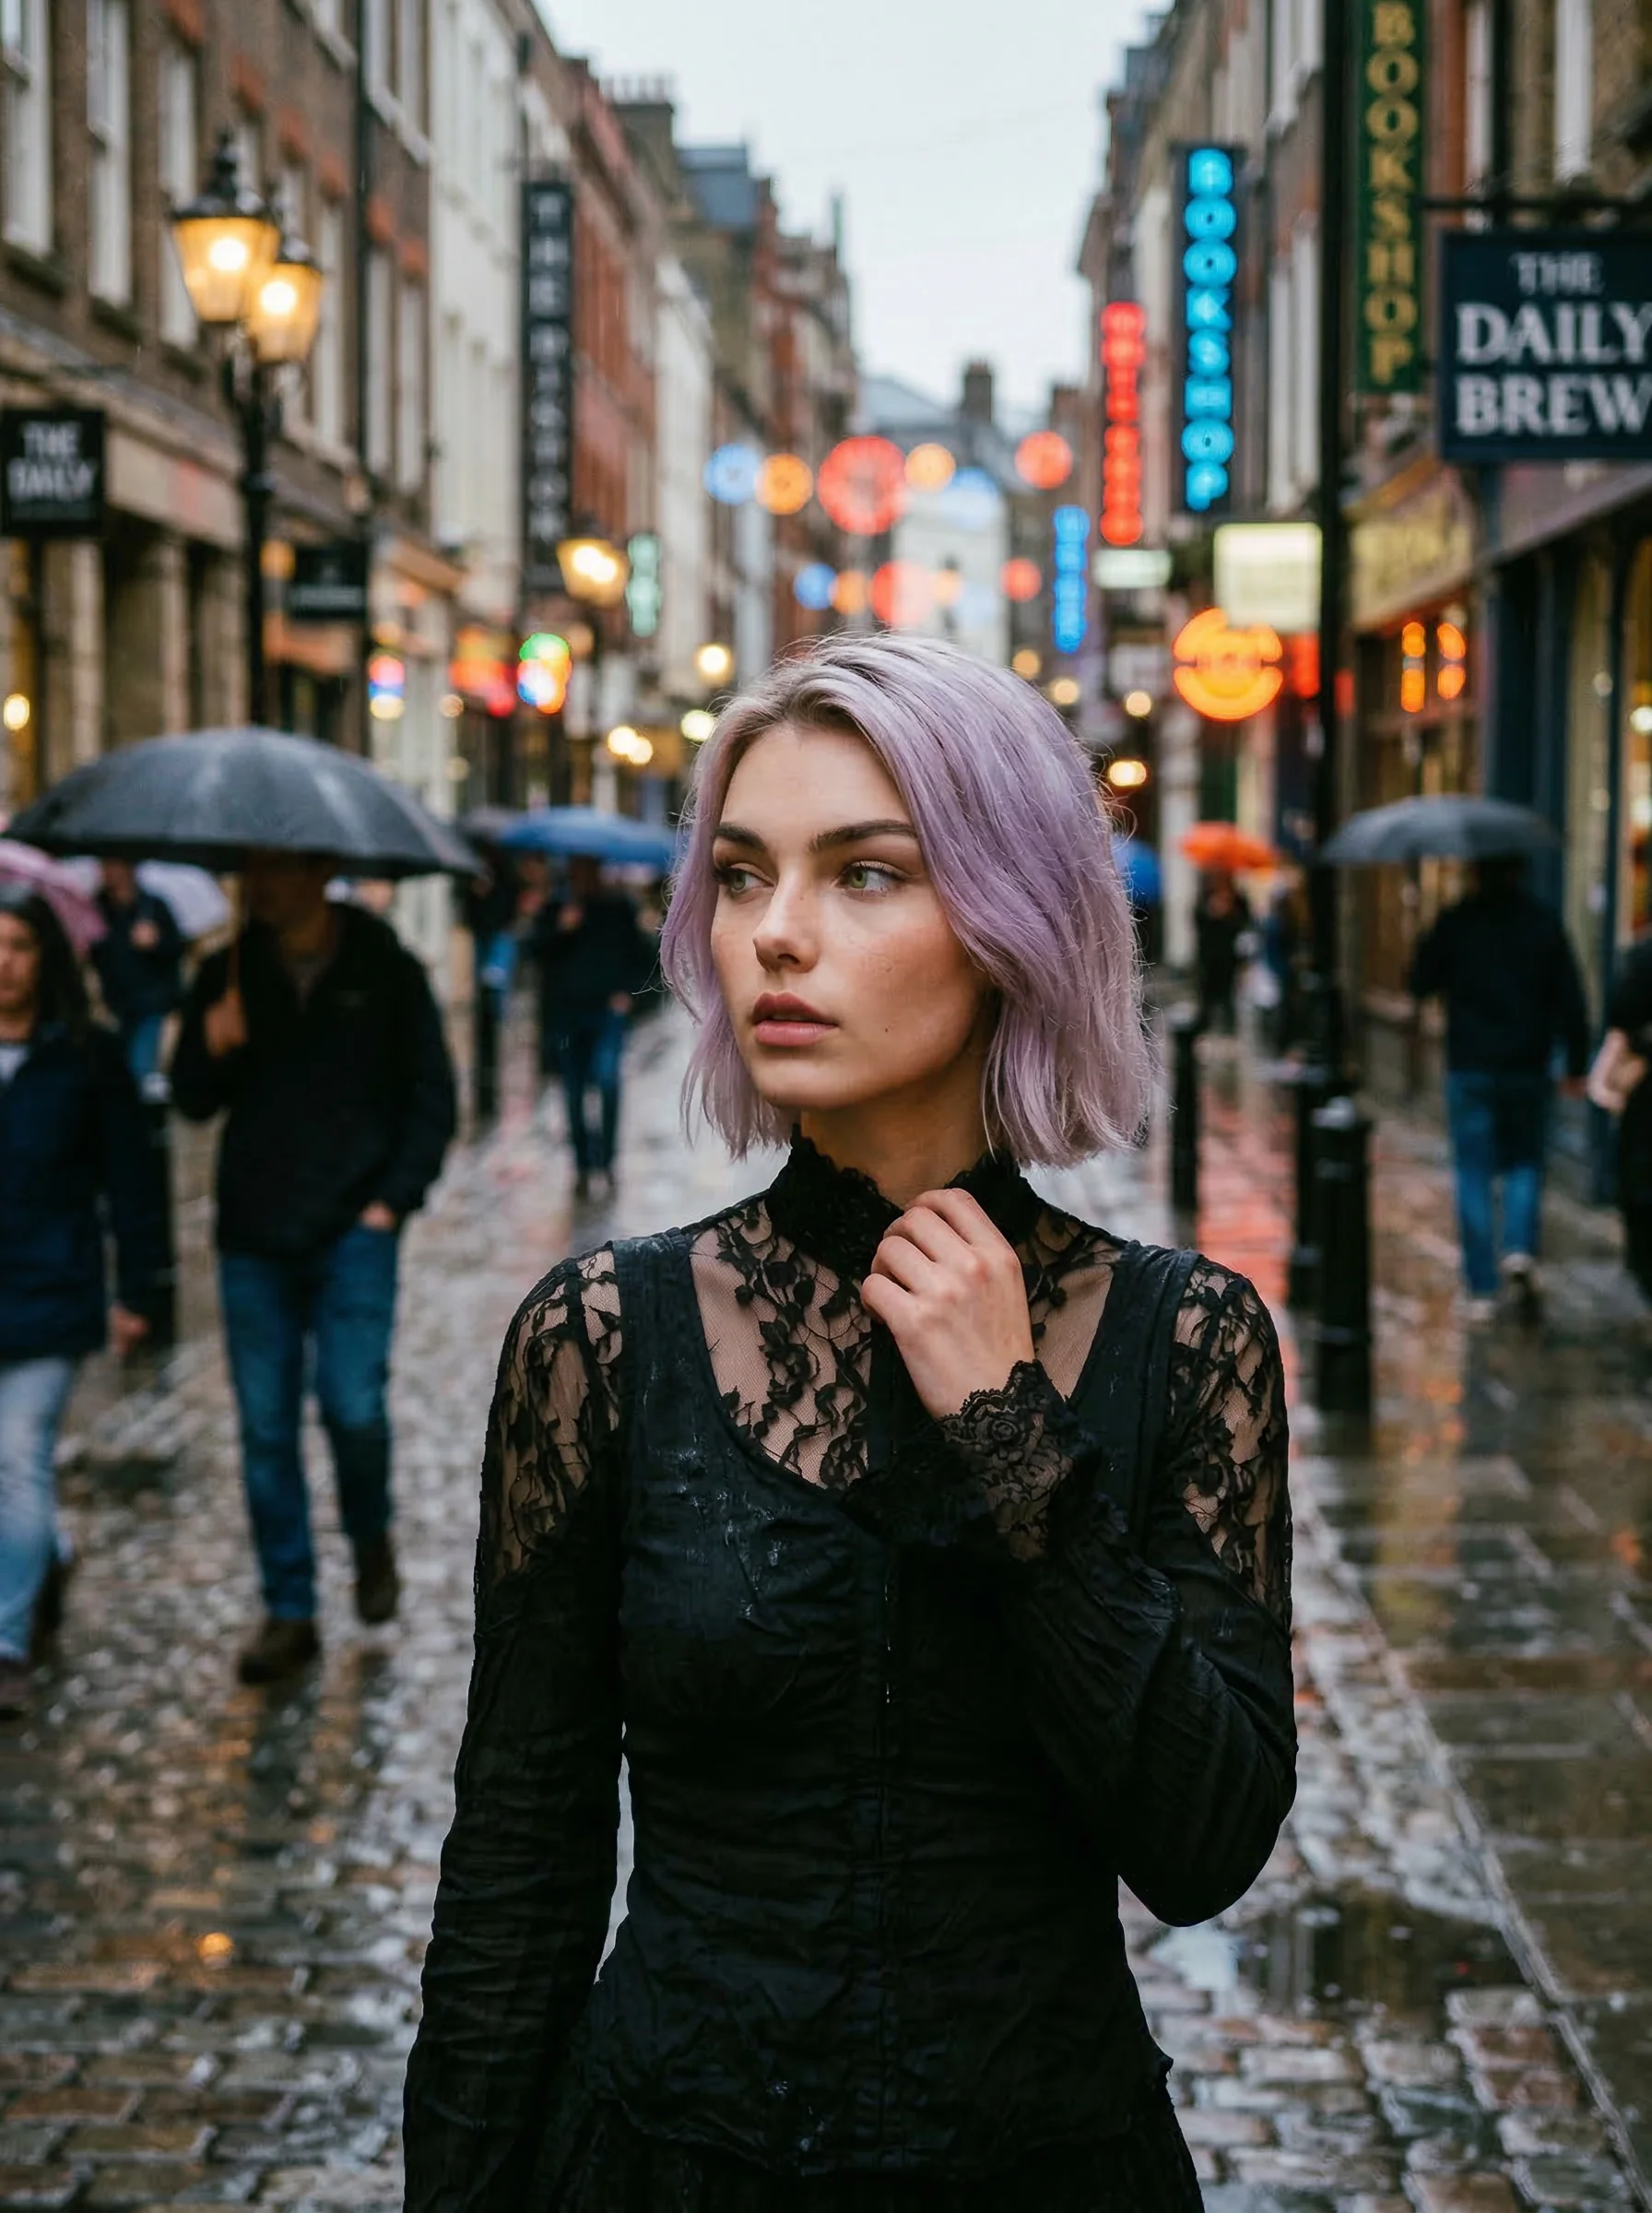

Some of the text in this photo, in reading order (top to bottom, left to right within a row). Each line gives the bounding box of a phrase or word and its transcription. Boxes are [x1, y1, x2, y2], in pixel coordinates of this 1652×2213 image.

[1365, 2, 1421, 385] BOOKSHOP
[1510, 250, 1603, 295] THE
[1182, 148, 1237, 512] BOOKSHOP
[1456, 302, 1652, 364] DAILY
[1456, 373, 1652, 436] BREW
